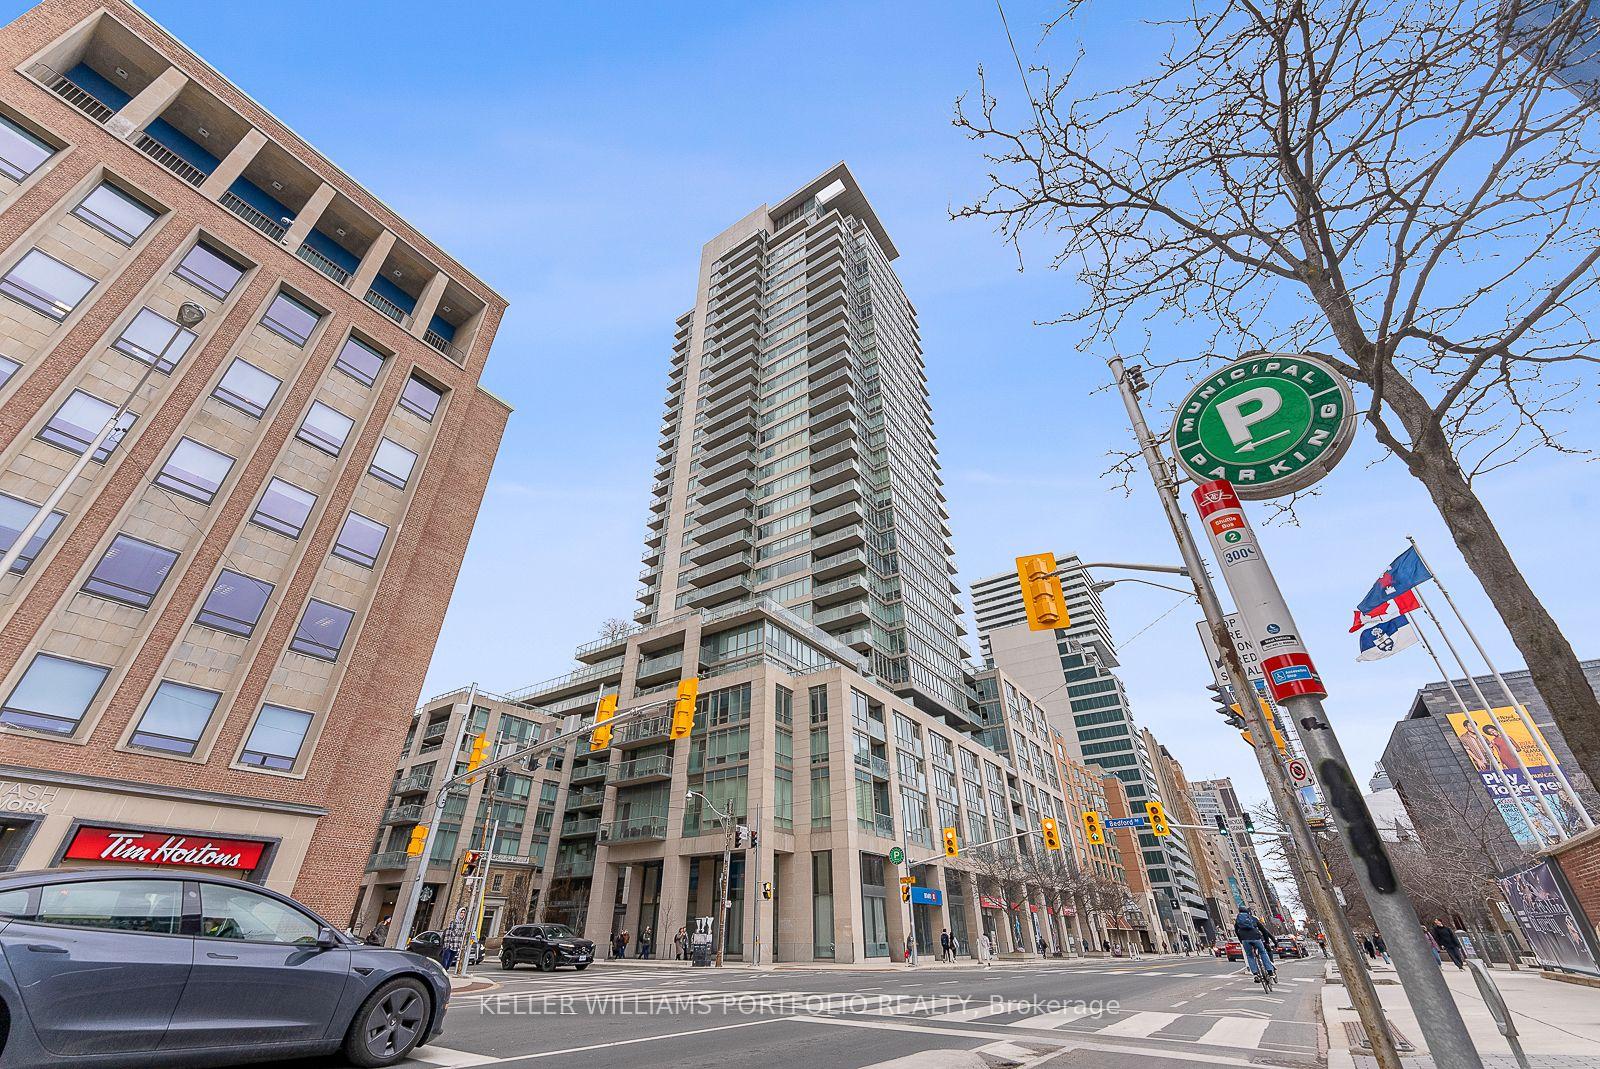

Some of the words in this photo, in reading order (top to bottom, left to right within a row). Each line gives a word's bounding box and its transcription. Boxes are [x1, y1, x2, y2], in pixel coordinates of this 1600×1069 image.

[1182, 362, 1315, 433] MUNICIPAL
[1216, 386, 1282, 447] P
[1190, 403, 1338, 482] PARKING
[1215, 516, 1237, 526] Shuttle
[1229, 533, 1237, 541] 2
[1225, 548, 1248, 563] 300
[1229, 630, 1243, 640] RE
[1237, 640, 1253, 651] ON
[1238, 652, 1257, 664] ED
[1487, 781, 1563, 797] Togeher
[100, 833, 151, 861] Tim
[150, 835, 241, 867] Hortons
